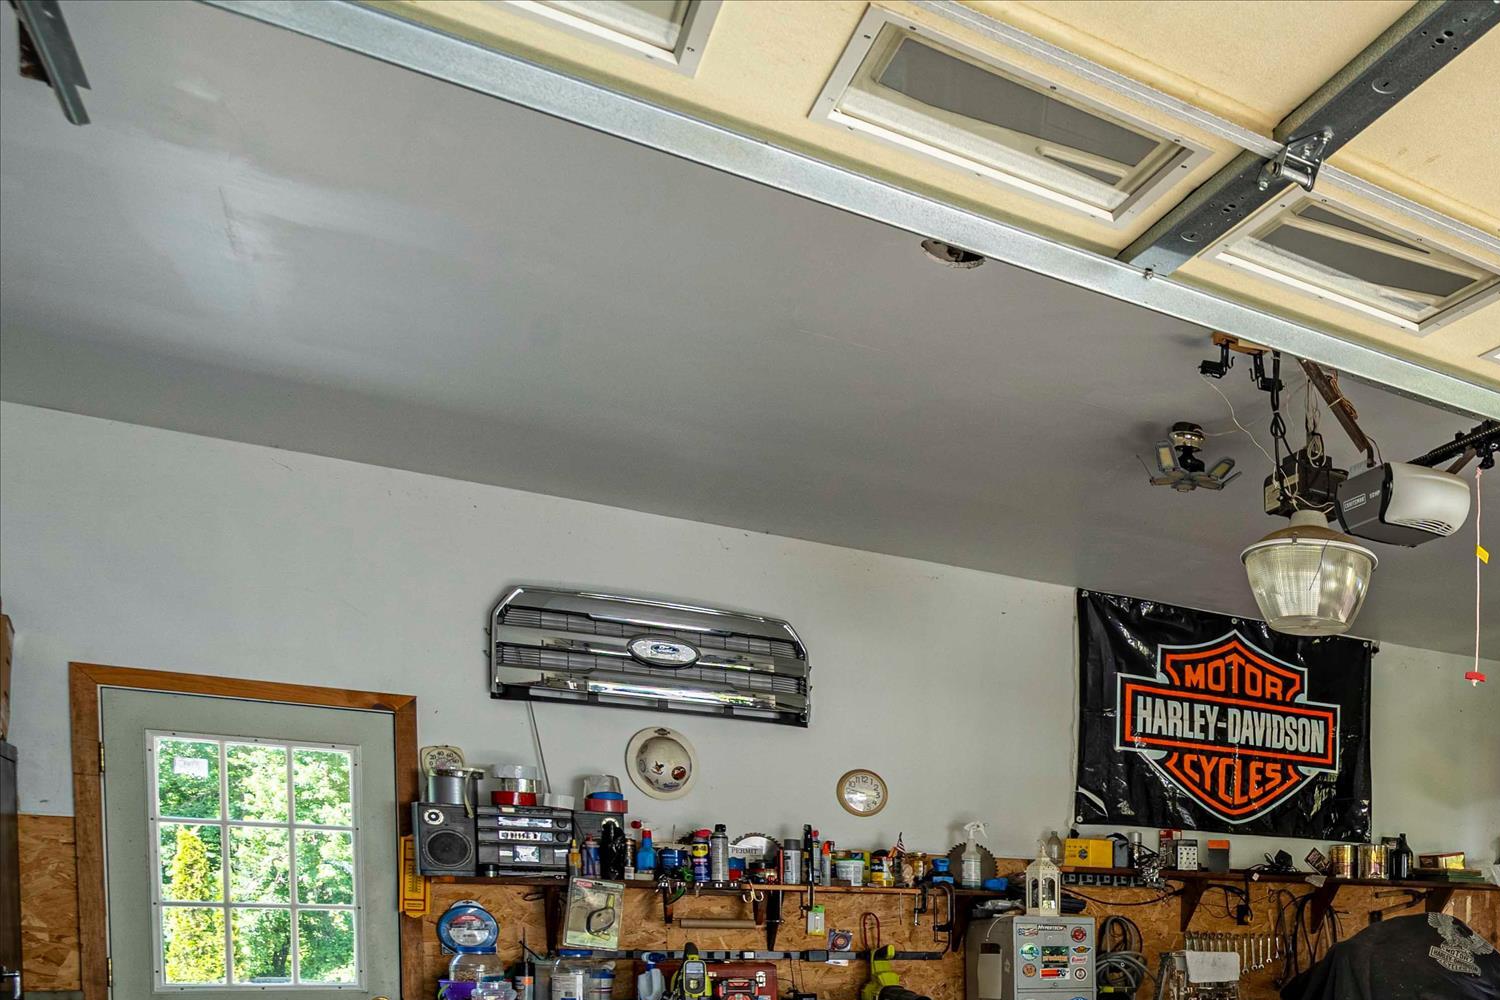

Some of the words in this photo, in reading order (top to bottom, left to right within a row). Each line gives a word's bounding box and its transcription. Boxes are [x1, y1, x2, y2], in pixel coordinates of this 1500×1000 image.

[1184, 653, 1283, 701] MOTOR
[1136, 695, 1325, 754] HARLEY-DAVIDSON
[1183, 754, 1283, 805] CYCLES
